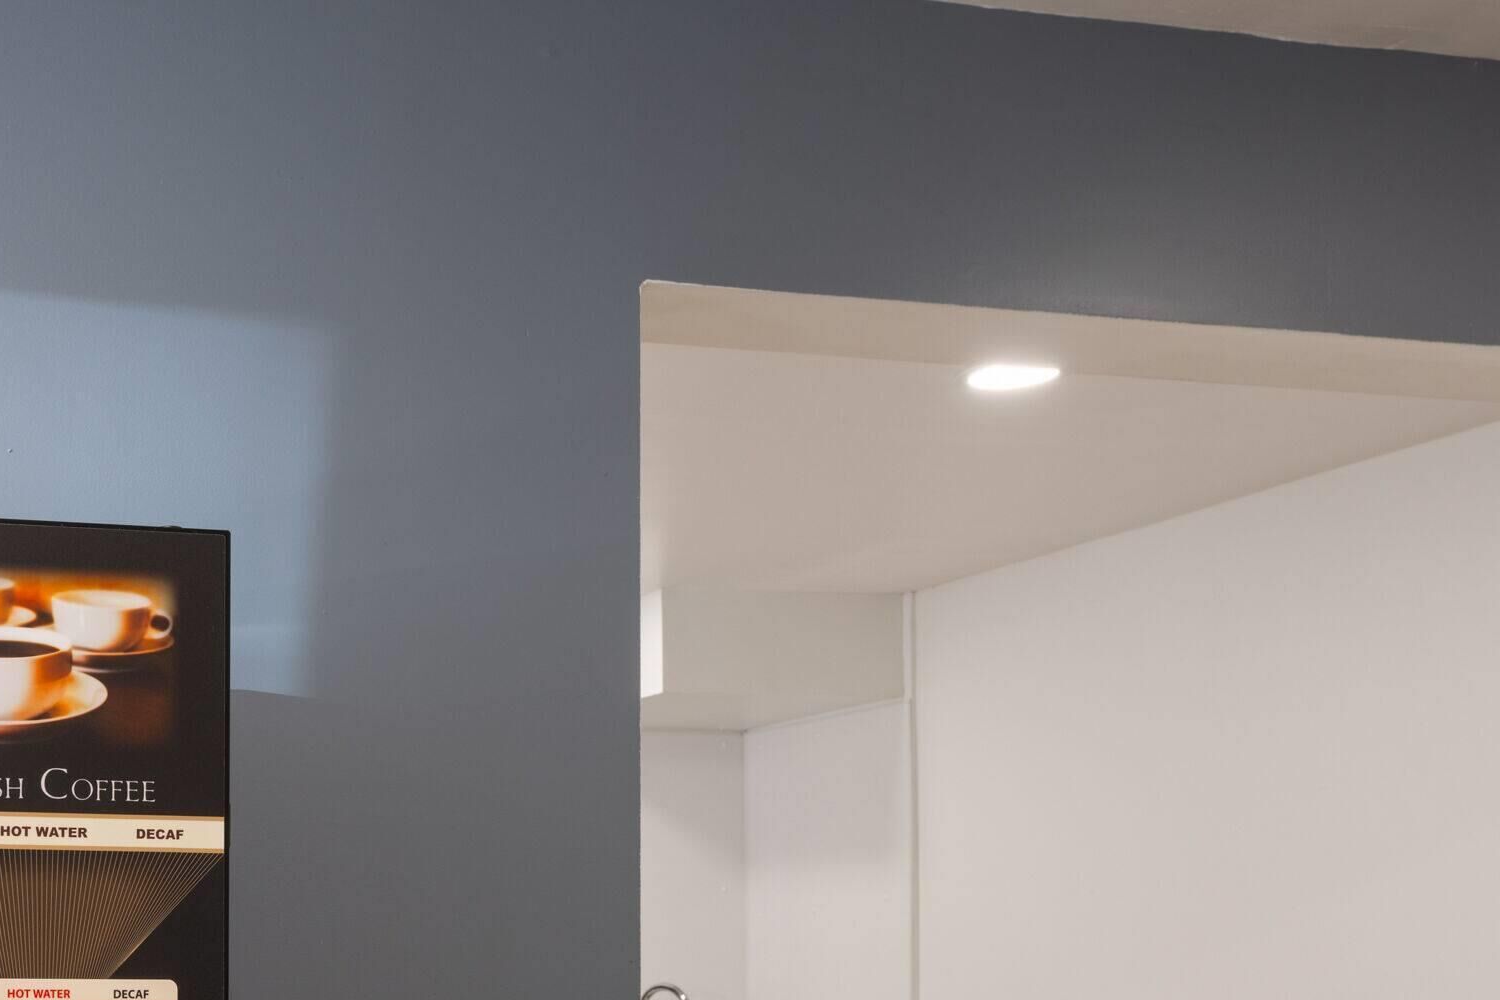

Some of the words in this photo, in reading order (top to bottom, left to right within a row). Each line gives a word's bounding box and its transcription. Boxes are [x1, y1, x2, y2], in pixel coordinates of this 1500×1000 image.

[0, 825, 31, 838] HOT
[35, 826, 88, 839] WATER
[136, 827, 185, 841] DECAF
[7, 988, 31, 999] HOT
[33, 989, 71, 999] WATER
[113, 989, 150, 999] DECAF
